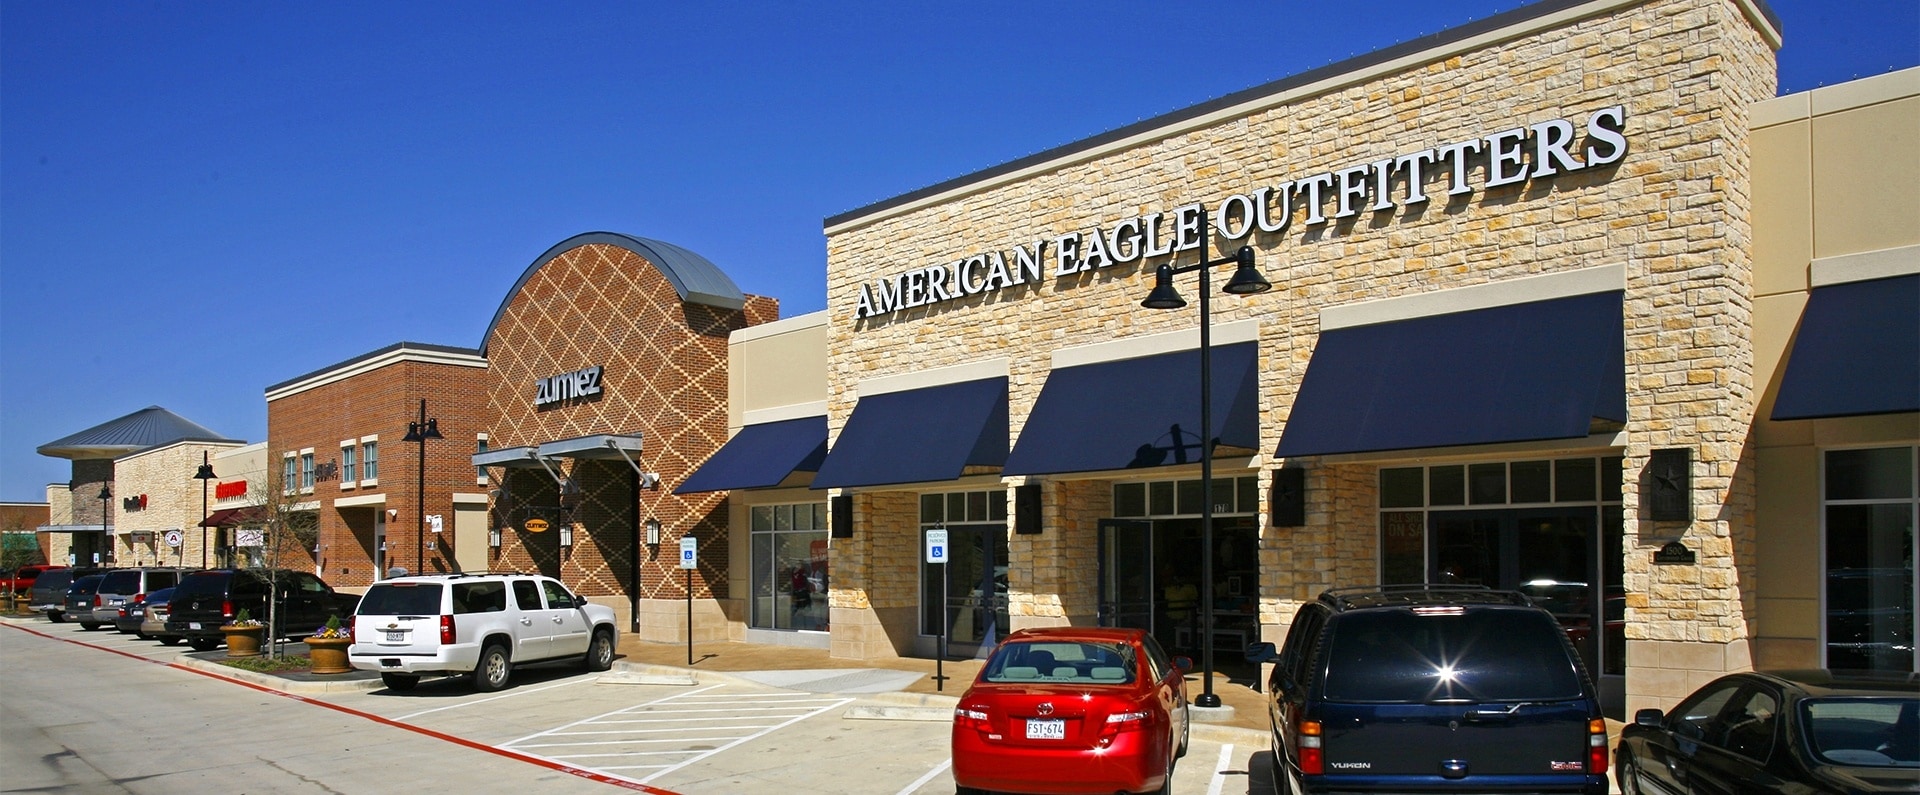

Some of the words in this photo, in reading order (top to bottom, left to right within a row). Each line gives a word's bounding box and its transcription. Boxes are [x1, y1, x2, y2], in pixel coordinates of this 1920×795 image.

[854, 240, 1048, 319] AMERICAN
[1054, 203, 1202, 277] EAGLE
[1216, 105, 1628, 240] OUTFITTERS
[1388, 523, 1405, 536] ON
[1666, 546, 1683, 555] 1500
